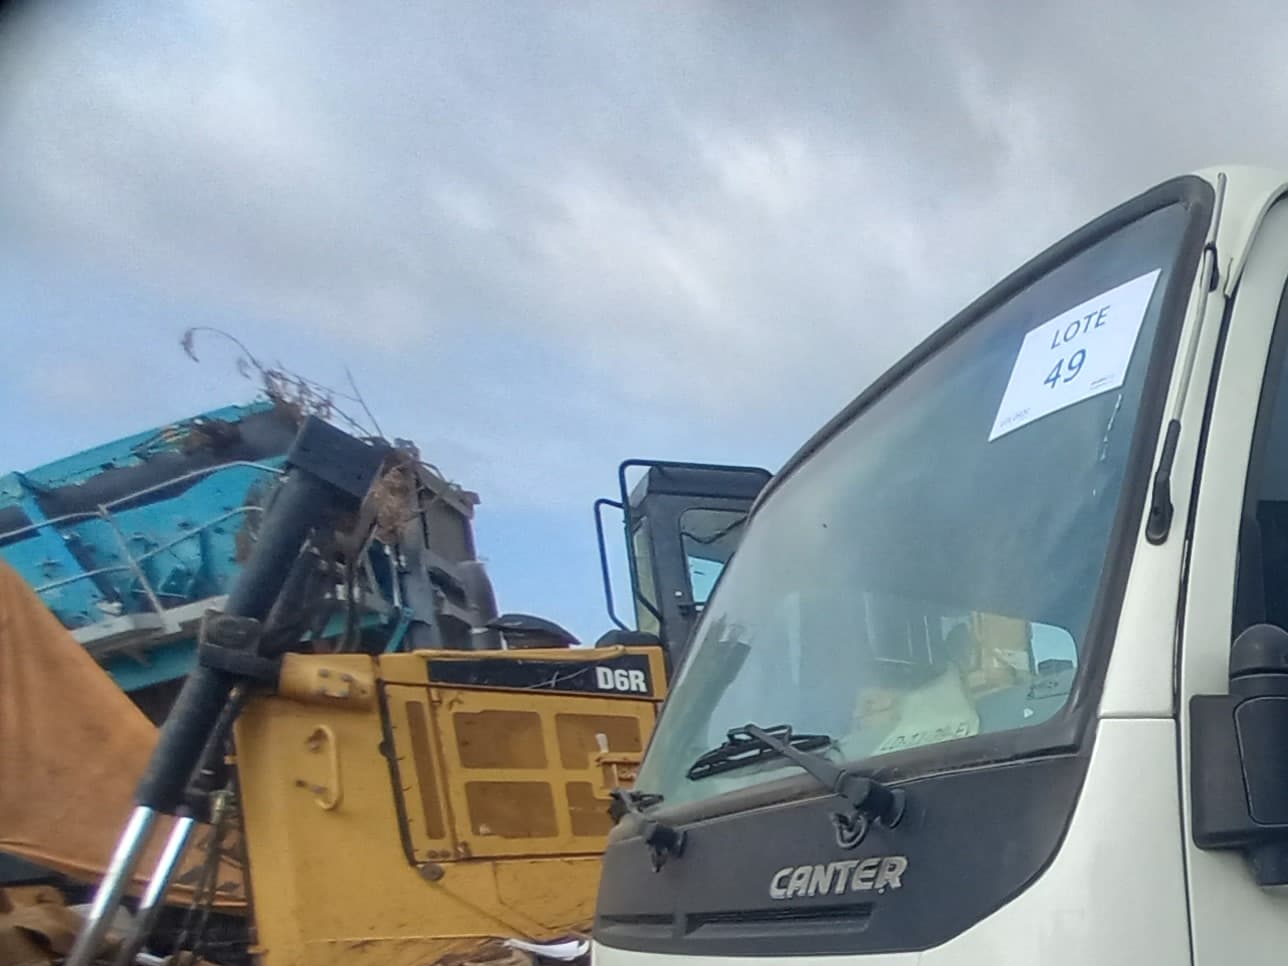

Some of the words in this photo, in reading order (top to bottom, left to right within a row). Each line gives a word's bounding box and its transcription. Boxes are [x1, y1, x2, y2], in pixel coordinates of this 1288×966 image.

[1050, 305, 1111, 350] LOTE
[1043, 348, 1087, 389] 49
[595, 666, 648, 692] D6R
[769, 855, 908, 900] CANTER
